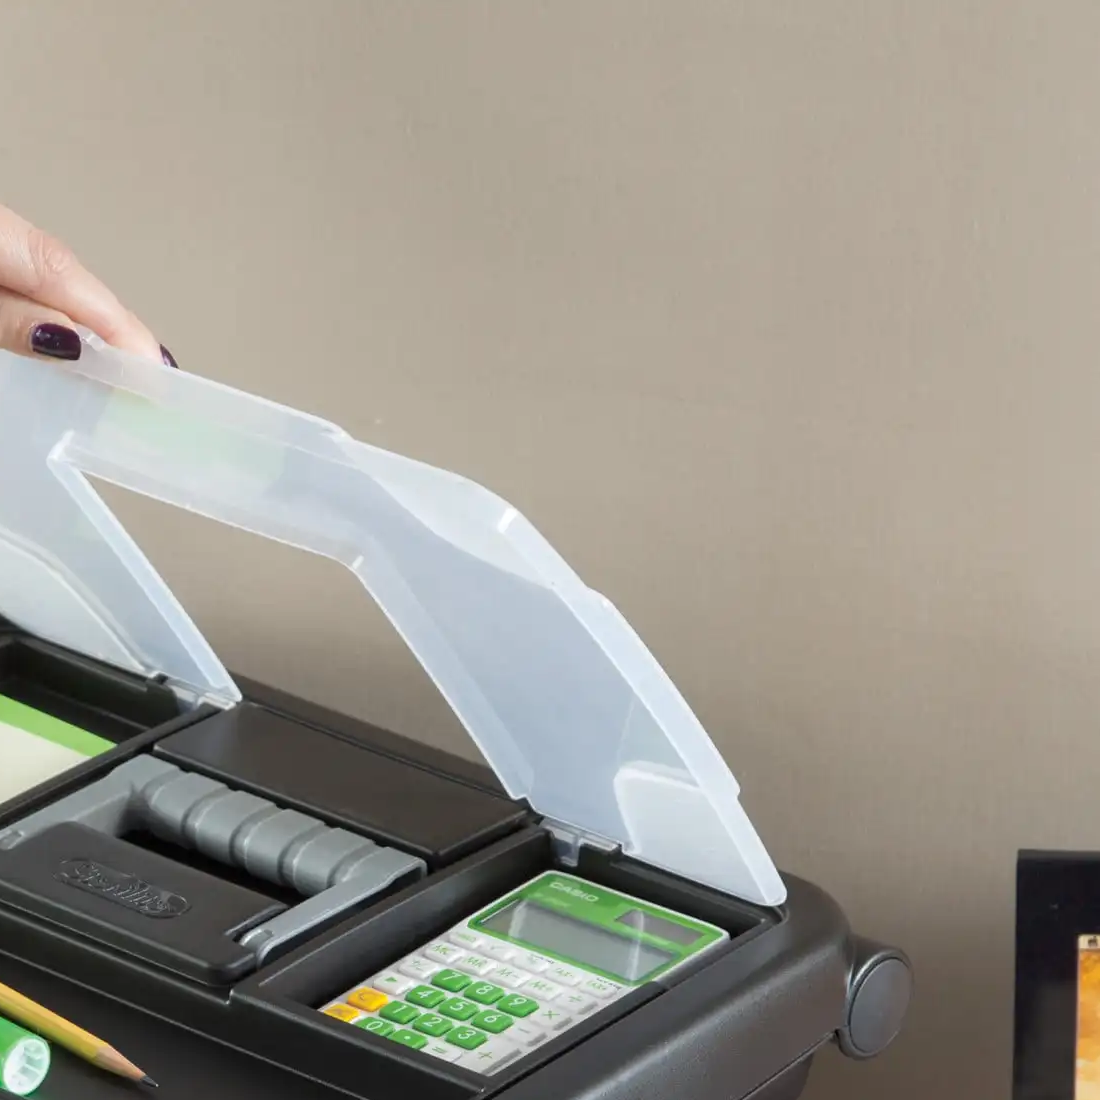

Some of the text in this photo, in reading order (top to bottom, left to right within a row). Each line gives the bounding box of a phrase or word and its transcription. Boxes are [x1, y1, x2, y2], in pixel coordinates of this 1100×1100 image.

[550, 882, 599, 902] CASIO
[443, 971, 462, 981] 7
[416, 989, 437, 999] 4
[475, 985, 494, 995] 8
[450, 1001, 469, 1011] 5
[508, 997, 528, 1007] 9
[393, 1005, 408, 1014] 1
[423, 1017, 442, 1028] 2
[484, 1012, 505, 1023] 6
[366, 1021, 384, 1031] 0
[458, 1029, 477, 1040] 3
